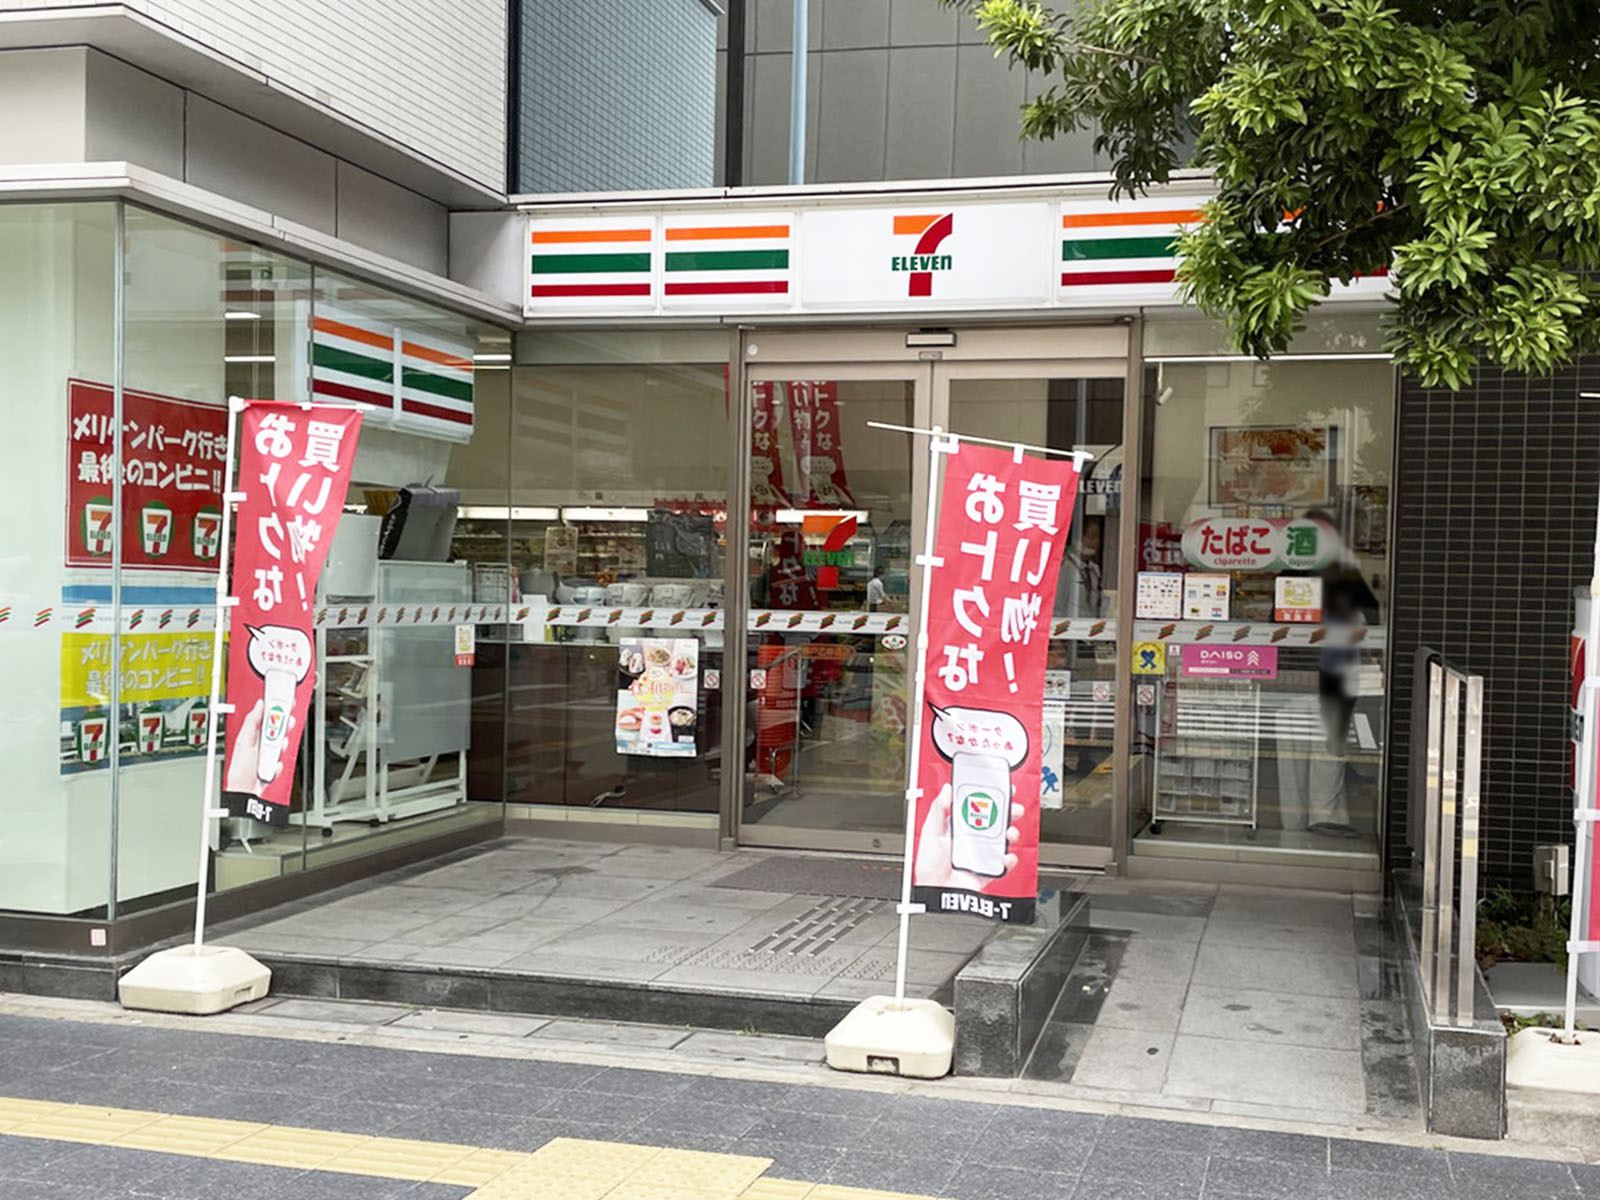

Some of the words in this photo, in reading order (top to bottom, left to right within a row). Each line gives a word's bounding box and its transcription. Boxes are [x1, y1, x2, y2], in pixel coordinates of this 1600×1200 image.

[893, 212, 953, 297] 7
[812, 381, 833, 451] トクな
[1201, 525, 1271, 556] たばこ
[1286, 526, 1318, 556] 酒
